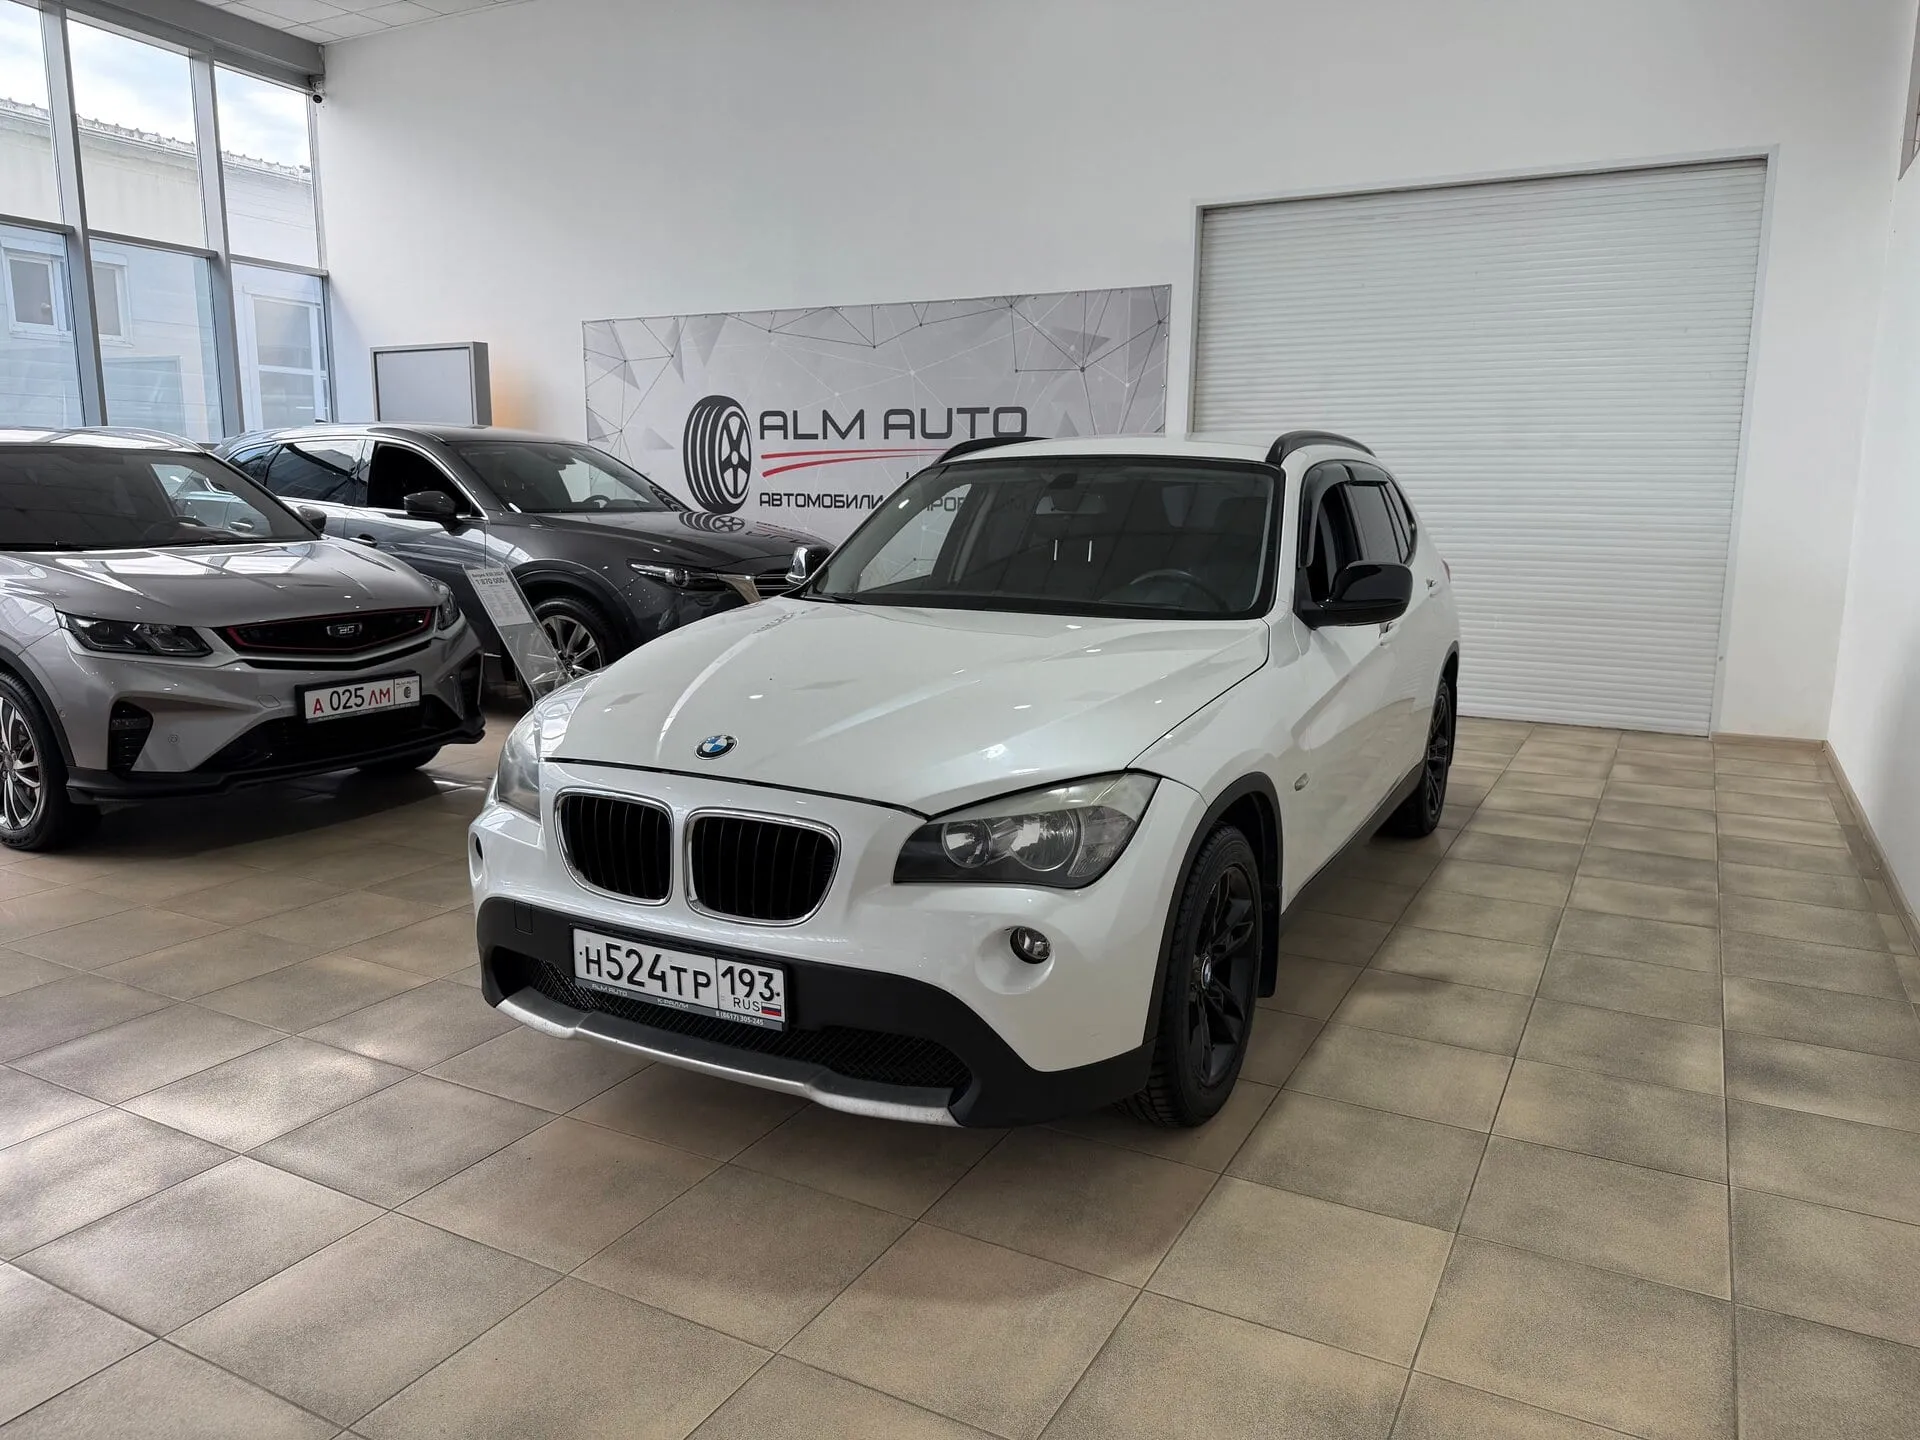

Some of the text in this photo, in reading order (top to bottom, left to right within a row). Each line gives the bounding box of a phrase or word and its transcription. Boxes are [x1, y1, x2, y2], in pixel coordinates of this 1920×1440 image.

[759, 406, 1027, 441] ALM AUTO
[329, 687, 365, 711] 025
[585, 942, 775, 1002] Н524ТР 193
[733, 997, 760, 1012] RUS
